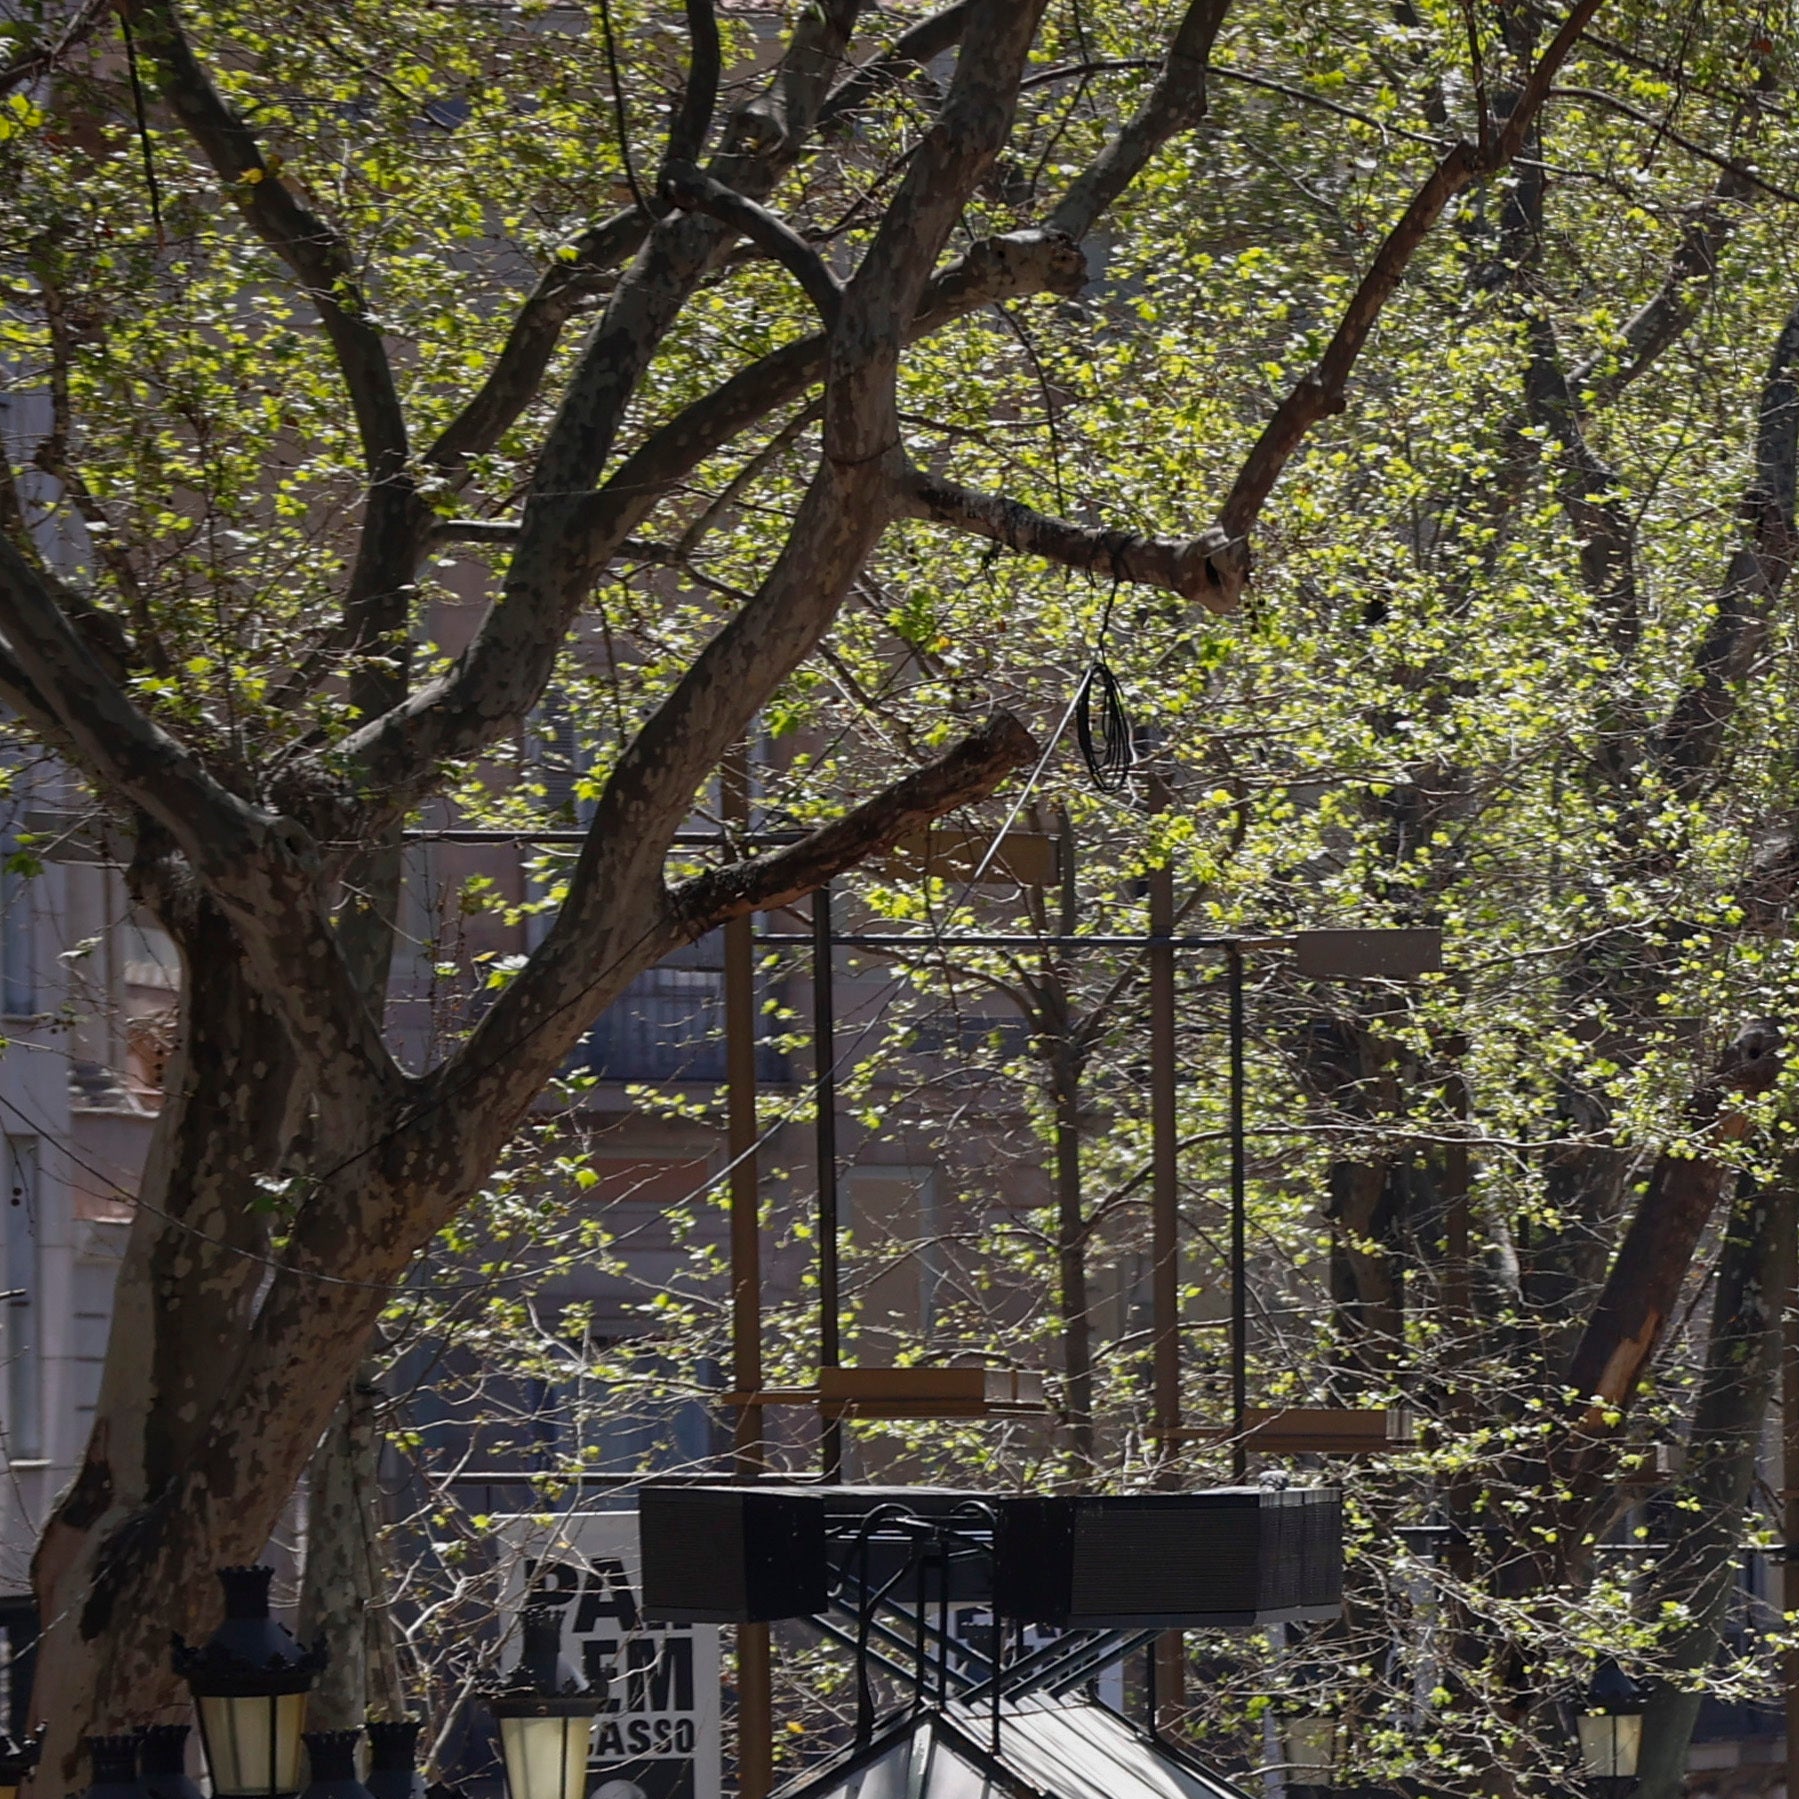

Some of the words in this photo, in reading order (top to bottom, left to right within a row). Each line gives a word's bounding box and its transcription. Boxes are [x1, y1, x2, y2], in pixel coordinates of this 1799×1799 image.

[525, 1557, 693, 1633] PA
[582, 1636, 694, 1713] EM
[588, 1718, 695, 1757] ASSO
